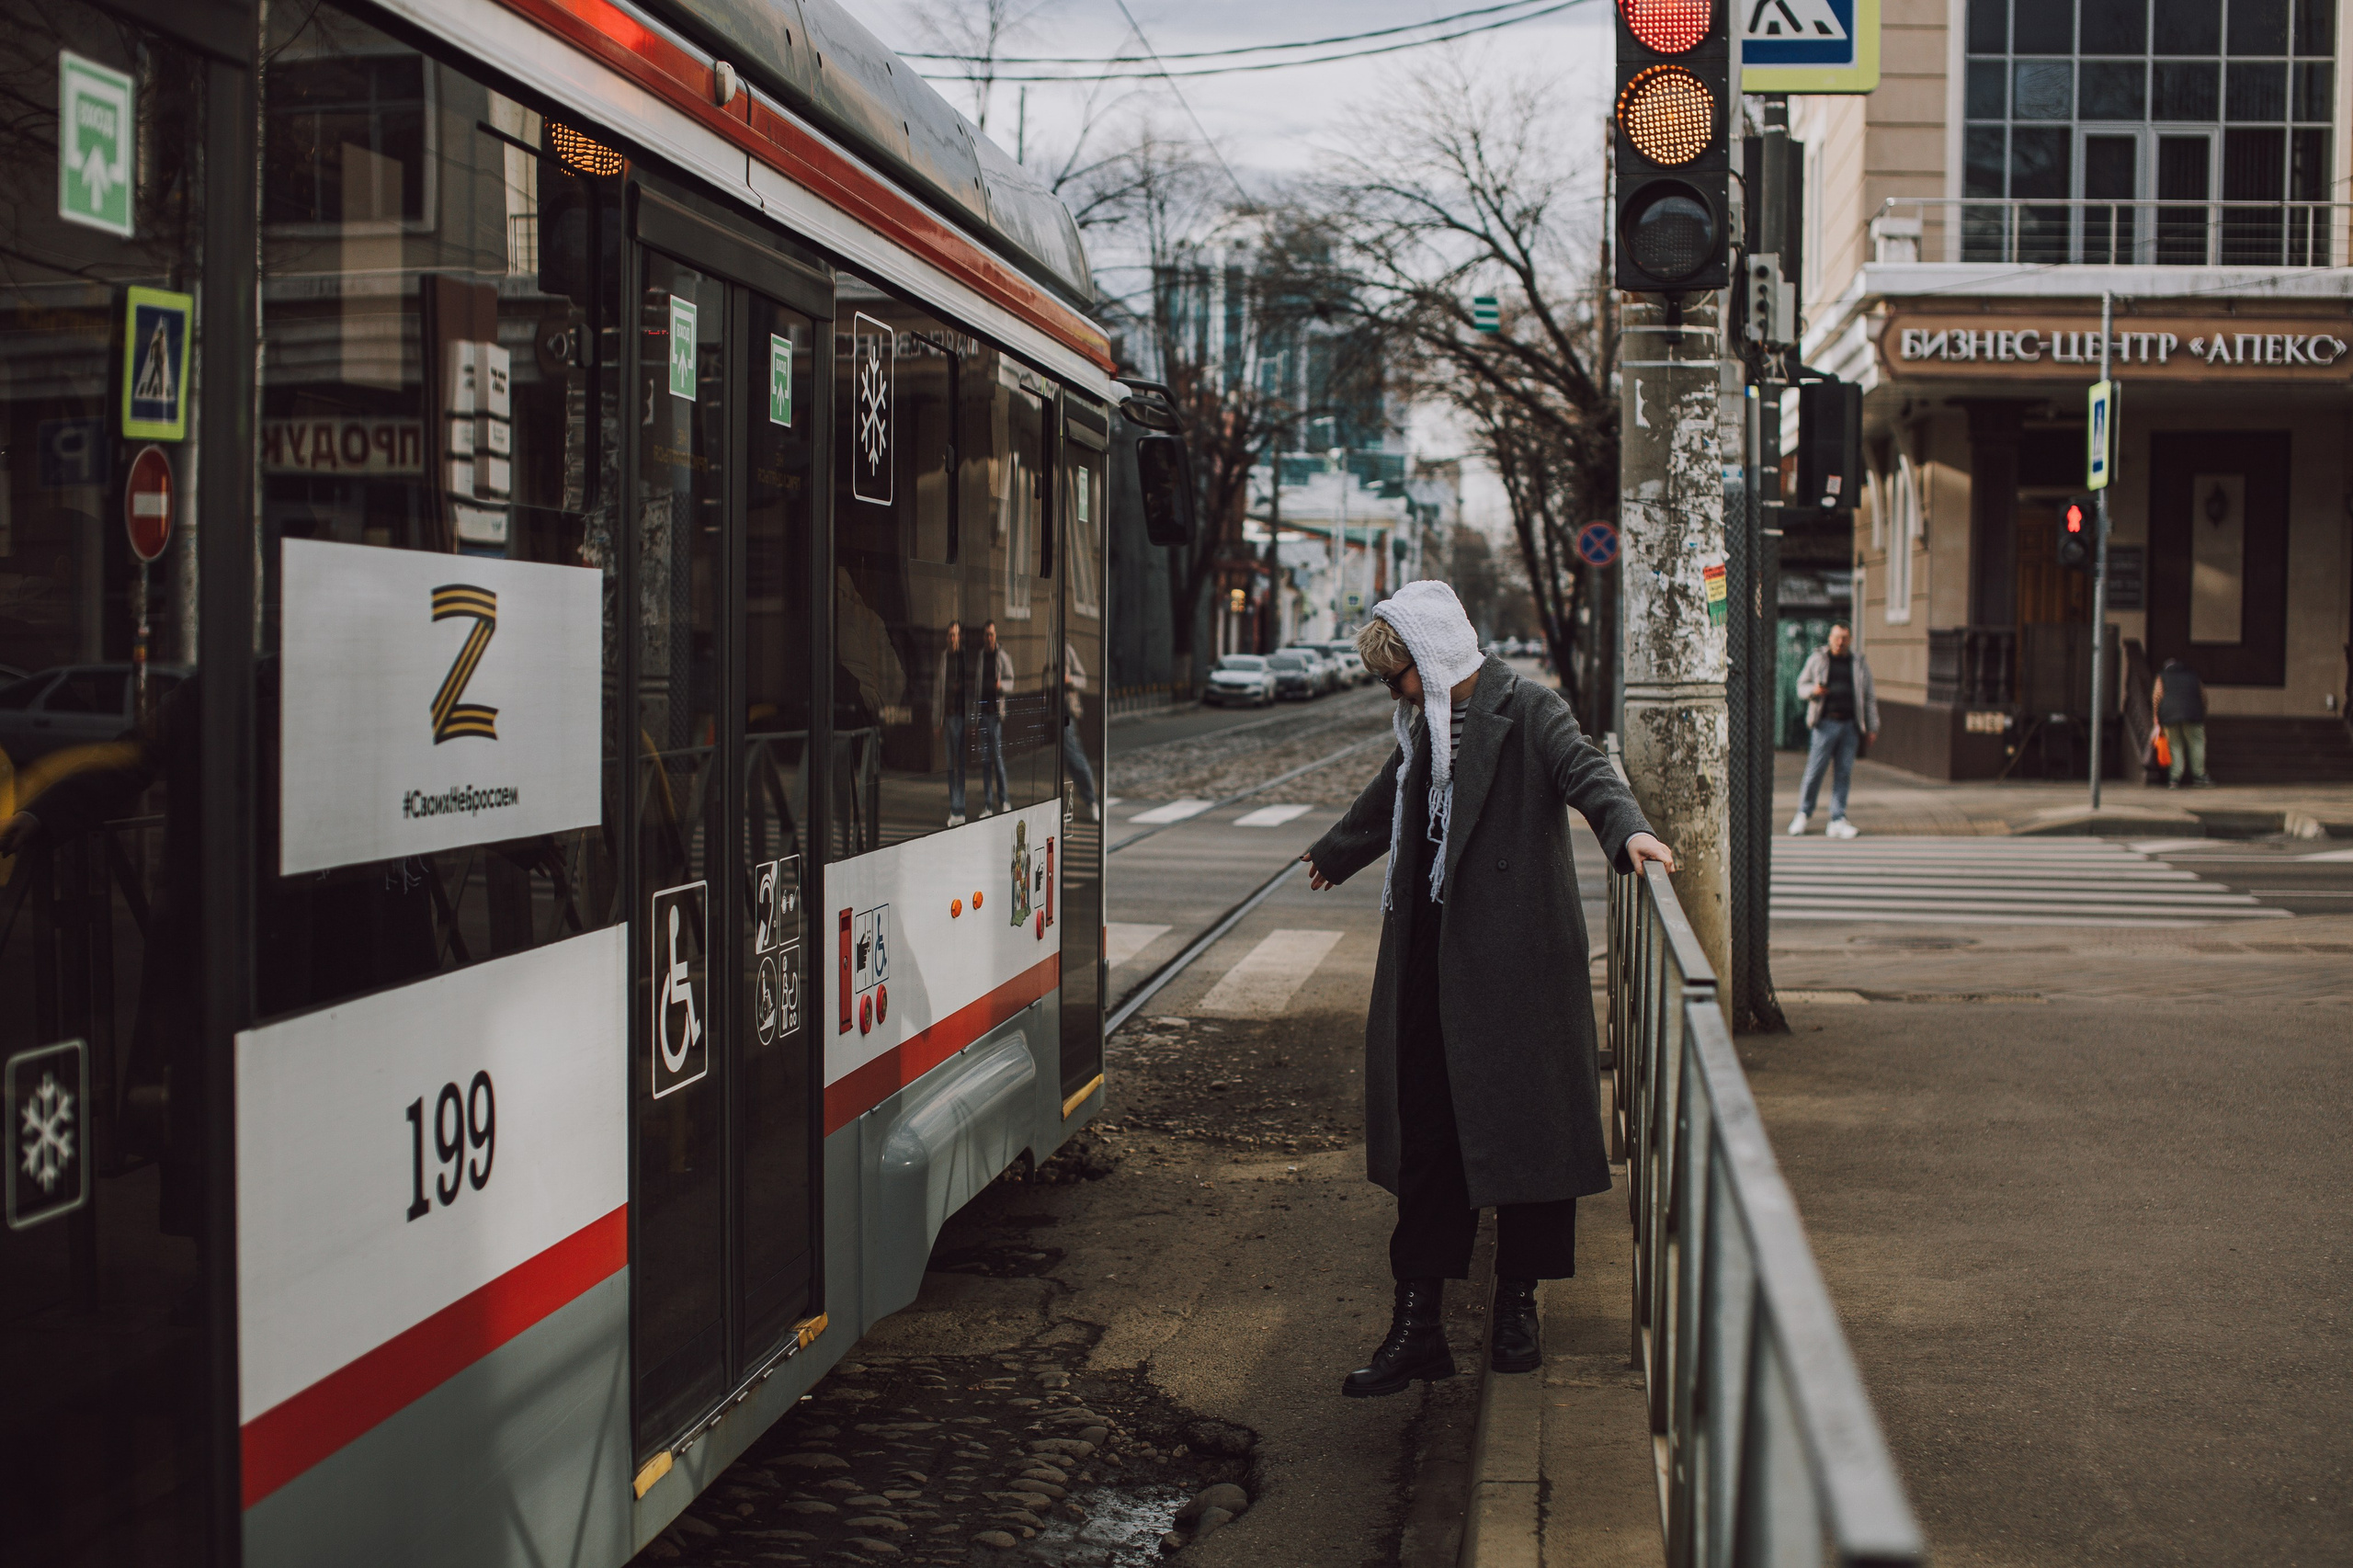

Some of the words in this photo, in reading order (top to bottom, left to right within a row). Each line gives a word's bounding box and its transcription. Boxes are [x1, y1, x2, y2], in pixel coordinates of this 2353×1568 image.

[677, 323, 690, 345] ВХОД
[1900, 328, 2177, 364] БИЗНЕС-ЦЕНТР
[2189, 332, 2348, 366] «АПЕКС»
[776, 358, 787, 377] ВХОД
[432, 585, 498, 744] Z
[403, 785, 518, 819] #СвоихНеБросаем
[406, 1071, 494, 1221] 199
